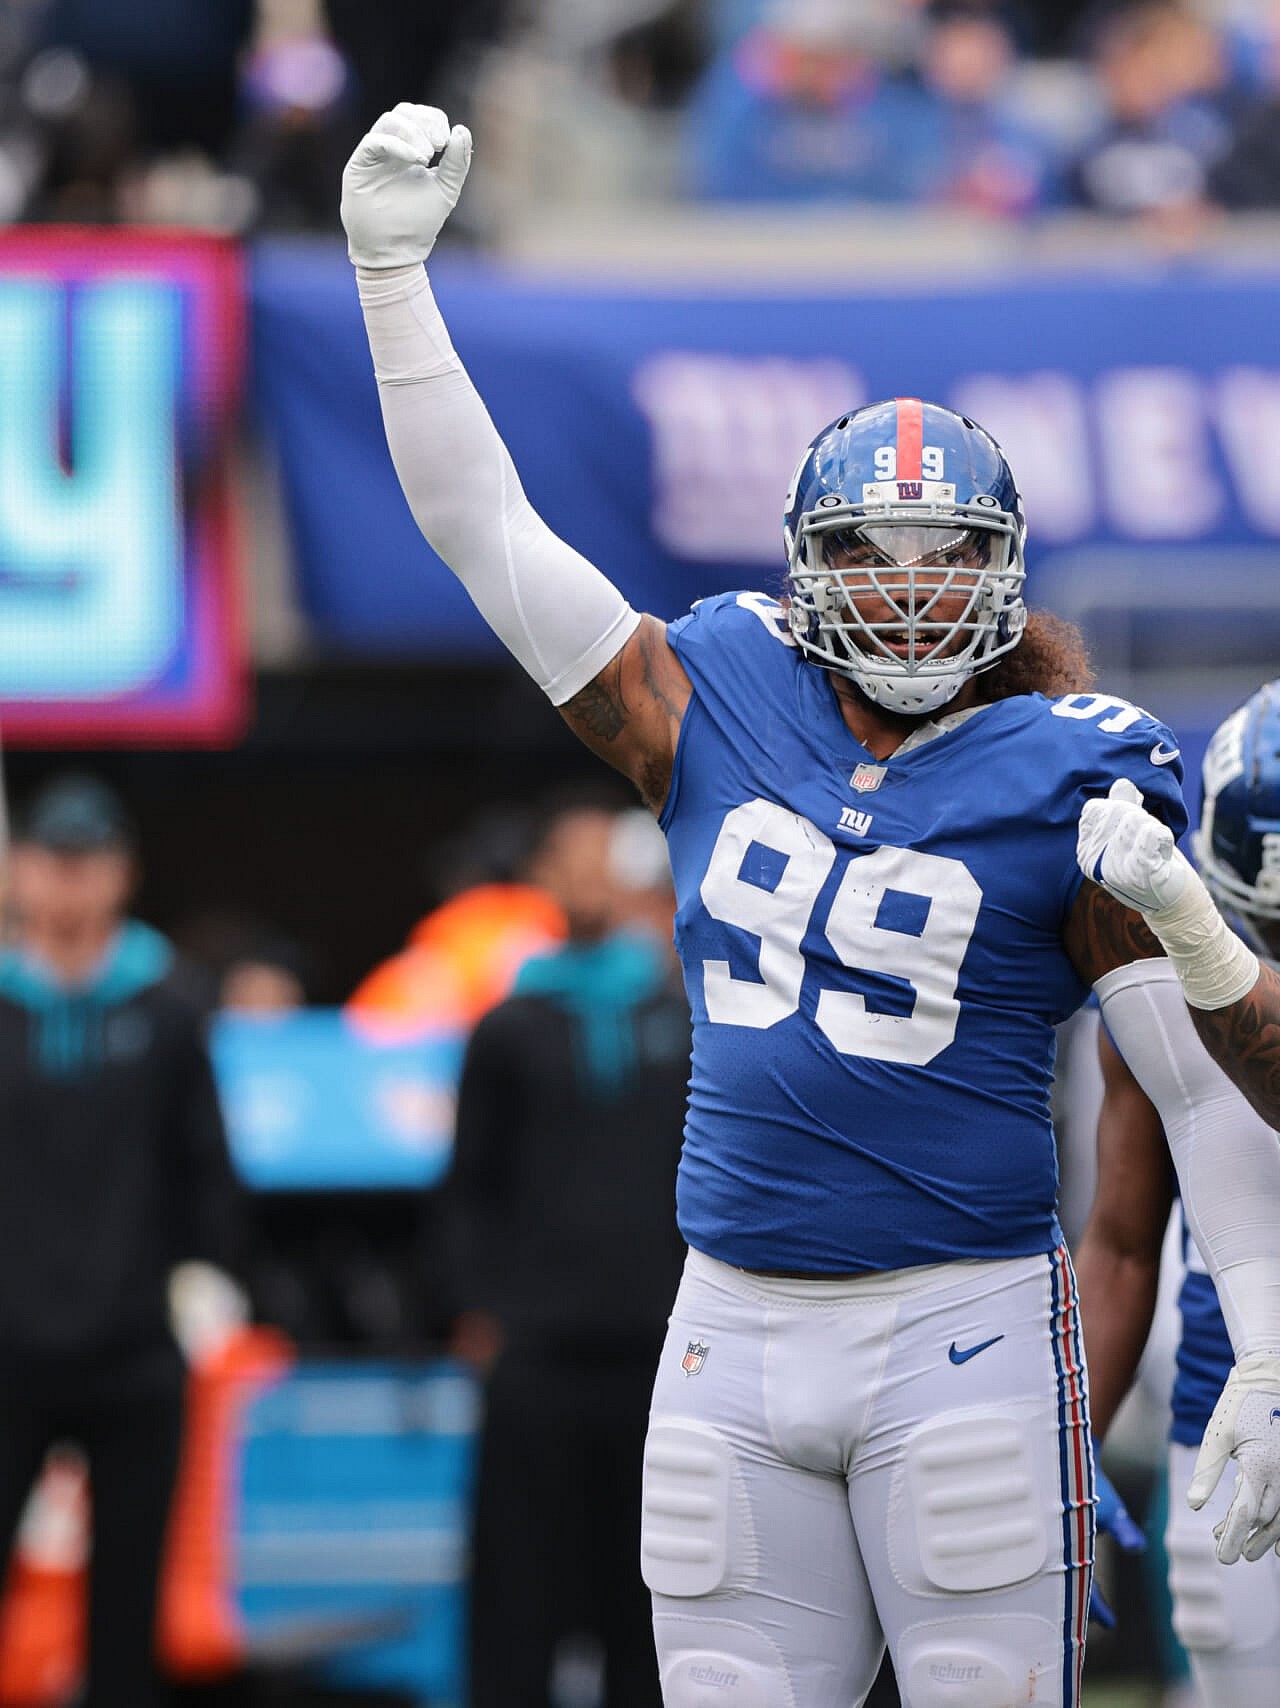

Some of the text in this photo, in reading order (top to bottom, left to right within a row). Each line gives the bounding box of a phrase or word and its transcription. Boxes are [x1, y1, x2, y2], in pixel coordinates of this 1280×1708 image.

[874, 446, 945, 480] 99
[700, 797, 984, 1067] 99
[929, 1662, 983, 1681] schutt
